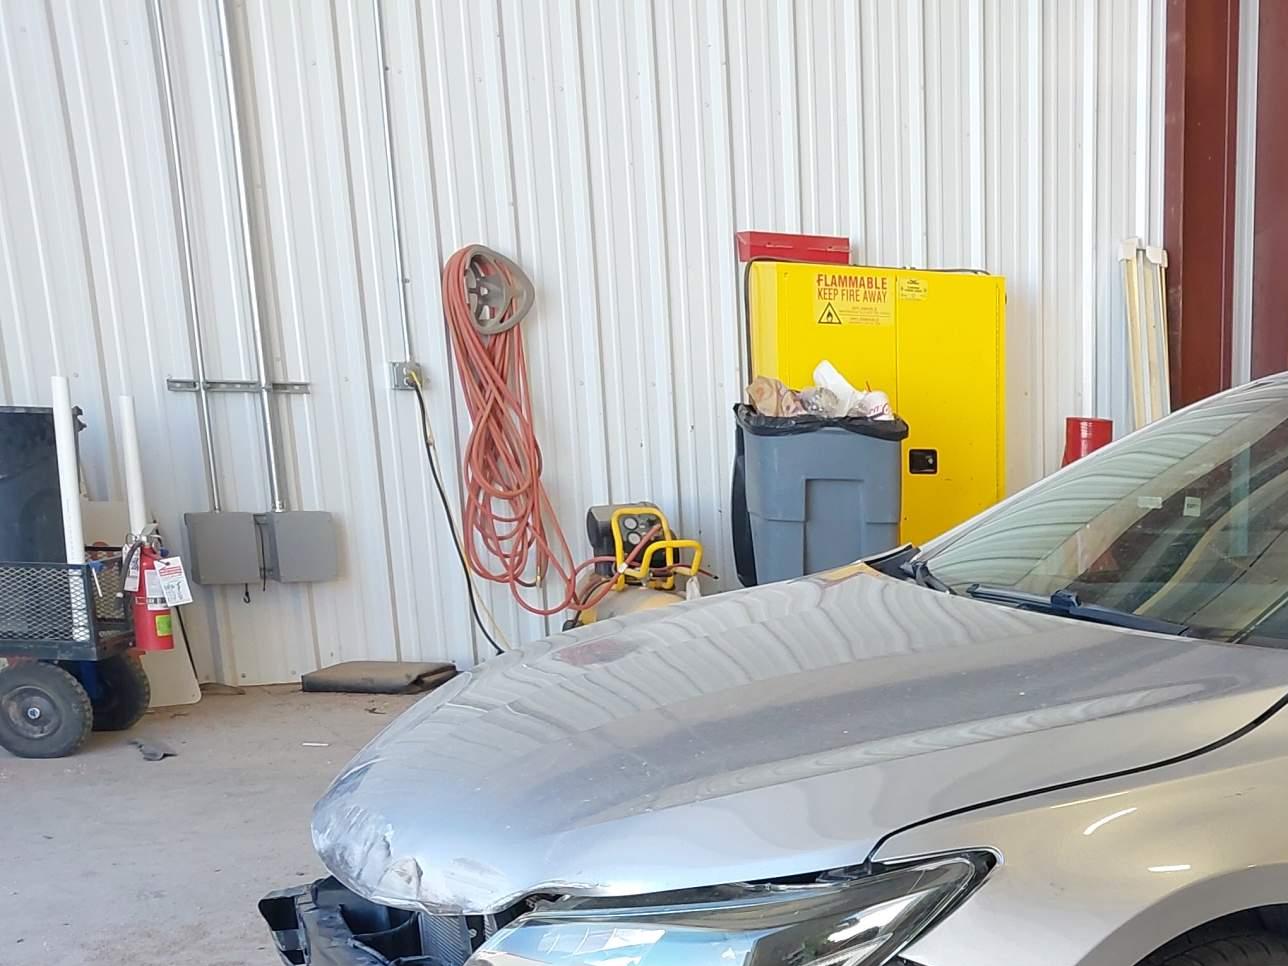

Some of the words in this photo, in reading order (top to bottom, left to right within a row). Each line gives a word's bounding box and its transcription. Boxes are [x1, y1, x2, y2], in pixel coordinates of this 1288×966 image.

[817, 274, 887, 289] FLAMMABLE
[818, 288, 838, 300] KEEP
[841, 289, 860, 302] FIRE
[863, 290, 887, 303] AWAY
